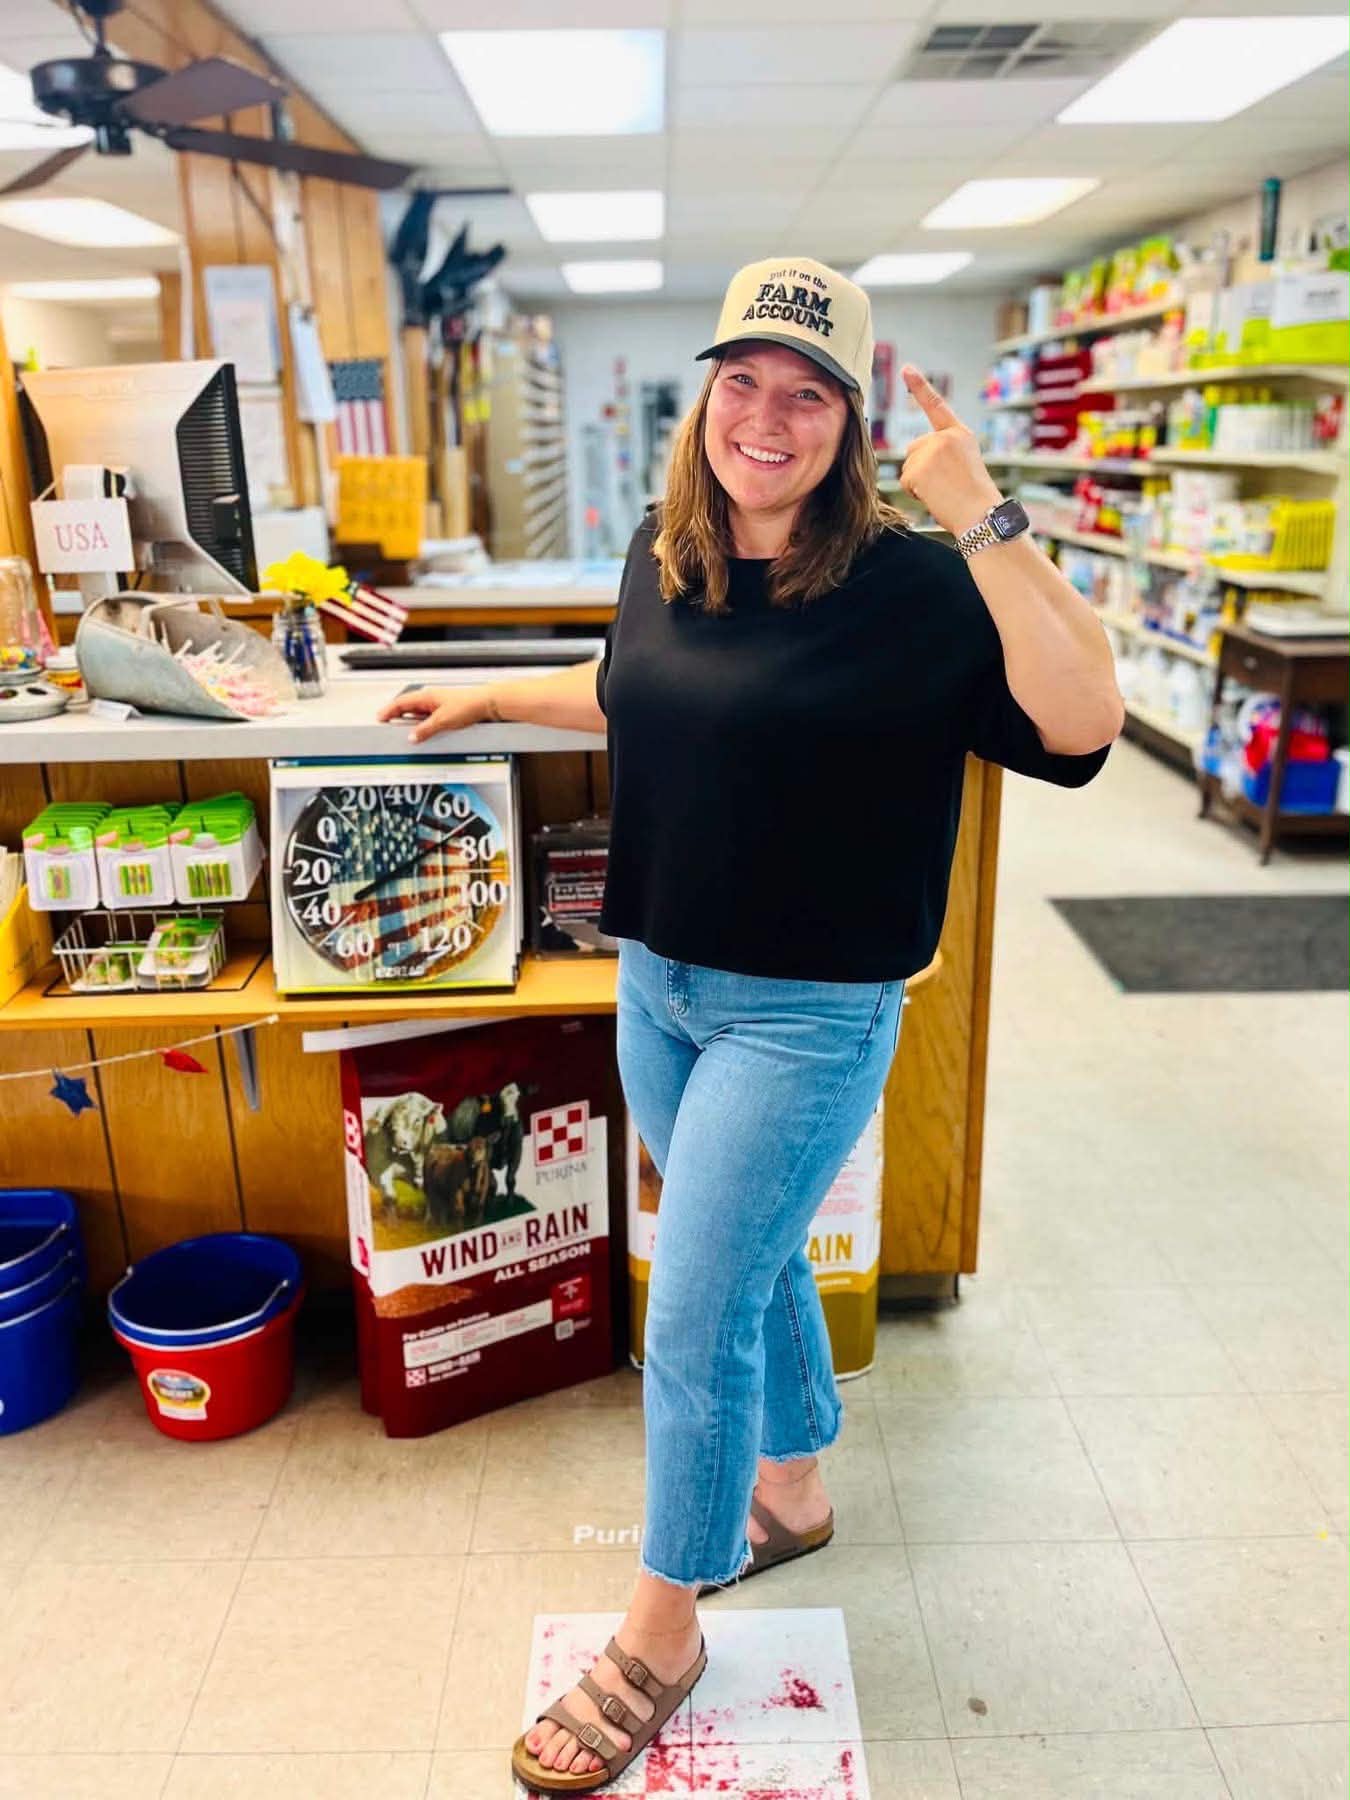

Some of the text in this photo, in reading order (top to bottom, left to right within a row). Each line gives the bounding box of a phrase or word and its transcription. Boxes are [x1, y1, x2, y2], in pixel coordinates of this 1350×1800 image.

[770, 268, 828, 290] put it on the
[755, 283, 832, 316] FARM
[742, 304, 834, 337] ACCOUNT
[54, 521, 109, 552] USA
[340, 786, 377, 811] 20
[385, 783, 422, 805] 40
[432, 791, 471, 818] 60
[460, 835, 496, 862] 80
[459, 880, 507, 906] 100
[421, 925, 472, 953] 120
[535, 1161, 588, 1186] PURINA
[420, 1231, 498, 1278] WIND
[525, 1203, 589, 1248] RAIN
[808, 1233, 854, 1264] AIN
[494, 1242, 591, 1284] ALL SEASON
[573, 1524, 641, 1545] Puri
